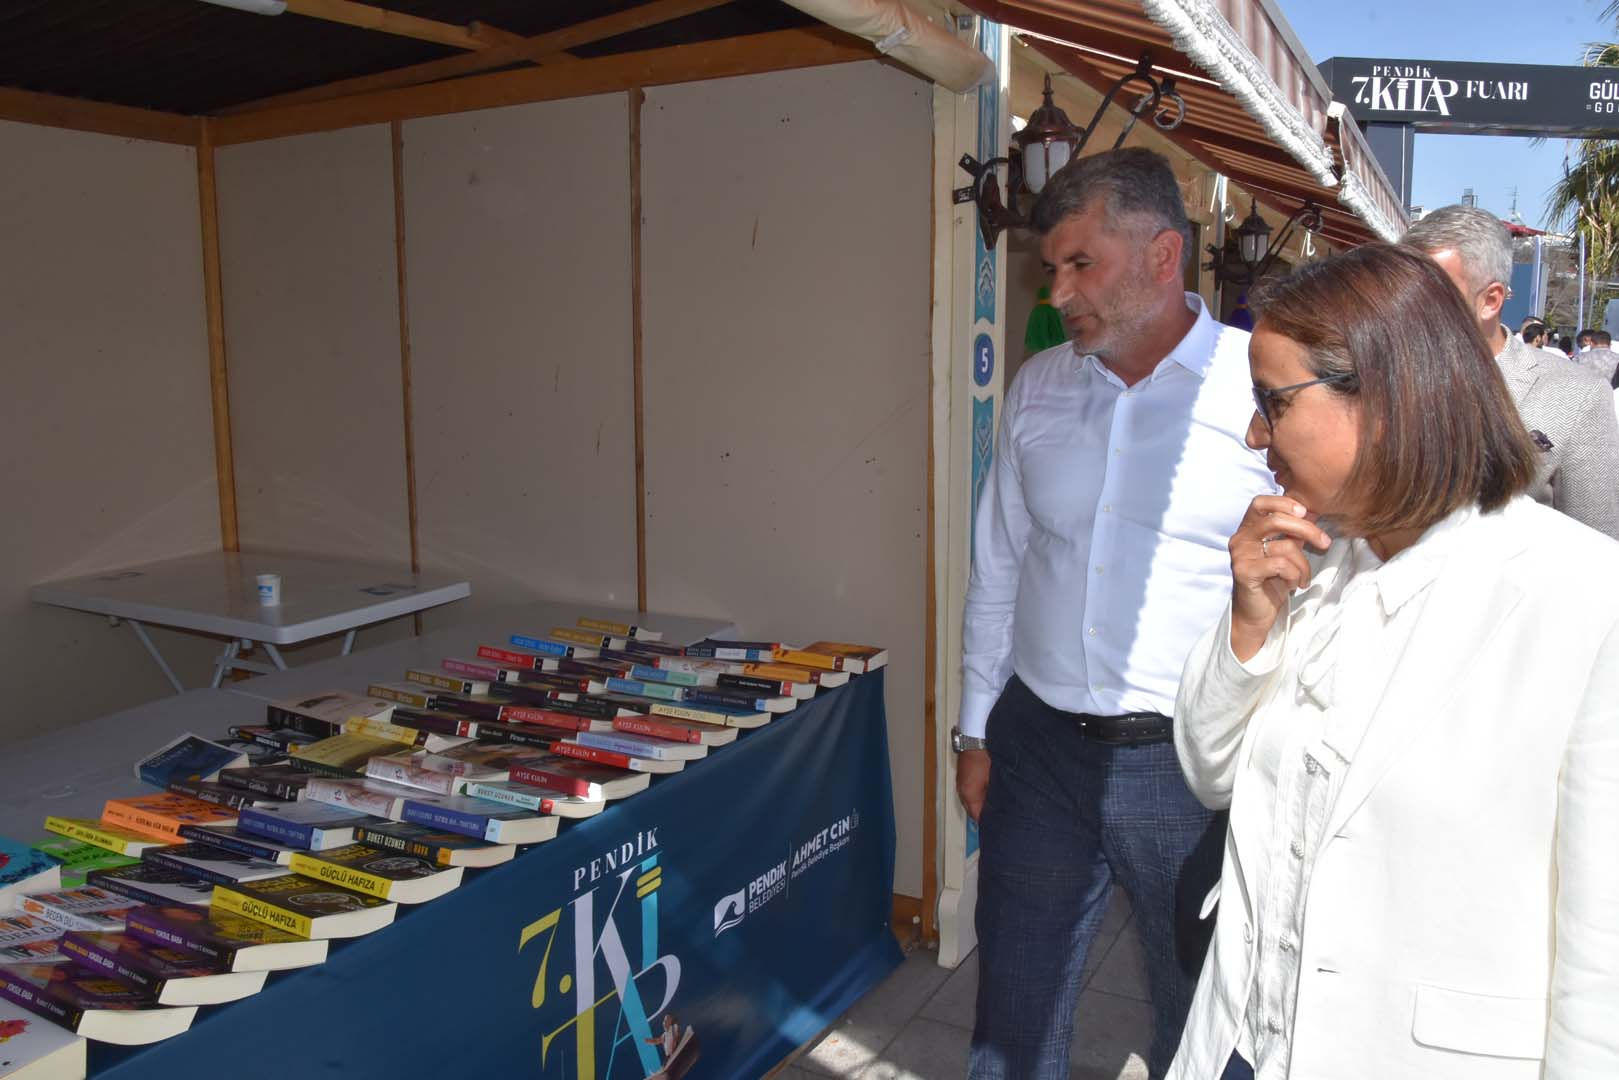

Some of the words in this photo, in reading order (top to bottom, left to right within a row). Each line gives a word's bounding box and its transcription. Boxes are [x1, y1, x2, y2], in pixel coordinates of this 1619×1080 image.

[1373, 65, 1432, 78] PENDİK
[1466, 80, 1528, 100] FUARI
[1595, 102, 1619, 113] GO
[981, 347, 989, 373] 5
[366, 830, 385, 847] BUKET
[385, 834, 406, 850] UZUNER
[792, 828, 829, 869] AHMET
[573, 826, 660, 891] PENDİK
[808, 848, 829, 868] Belediye
[320, 865, 348, 886] GÜÇLÜ
[348, 873, 376, 892] HAFIZA
[749, 860, 787, 900] PENDİK
[749, 878, 786, 913] BELEDİYESİ
[242, 900, 268, 920] GÜÇLÜ
[269, 910, 297, 930] HAFIZA
